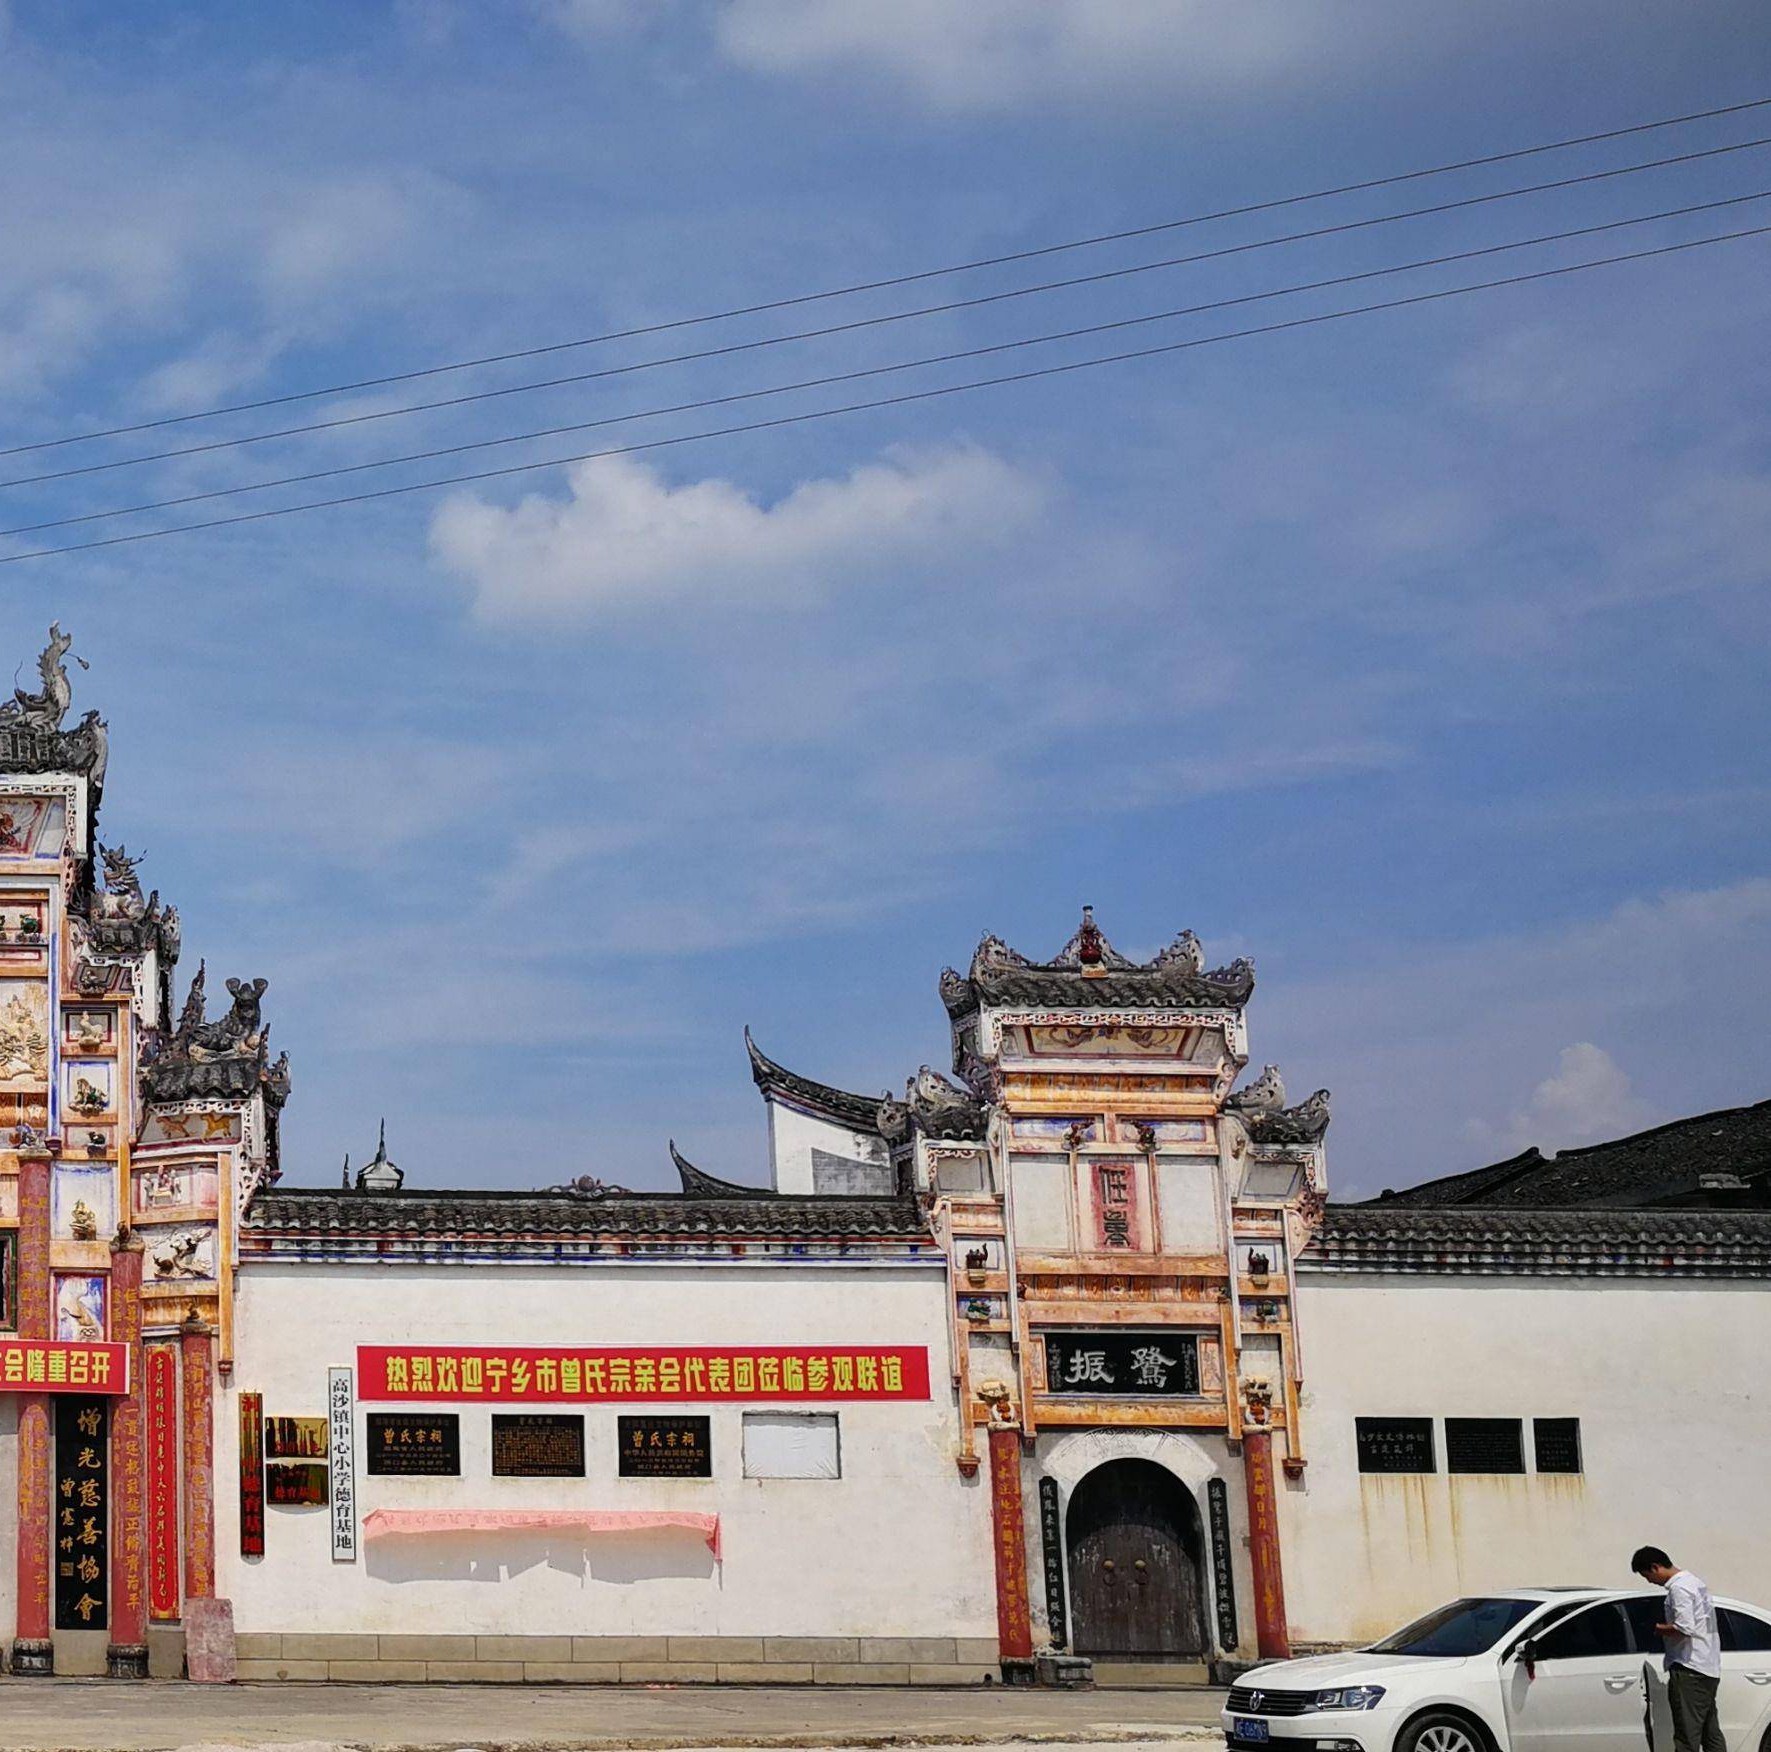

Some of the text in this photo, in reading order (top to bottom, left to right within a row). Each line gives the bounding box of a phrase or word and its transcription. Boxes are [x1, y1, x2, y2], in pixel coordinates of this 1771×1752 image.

[386, 1356, 903, 1393] 热烈欢迎宁乡市曾氏宗亲会代表团莅临参观联谊
[383, 1427, 442, 1444] 曾氏宗祠
[632, 1430, 695, 1447] 曾氏宗祠
[332, 1378, 353, 1551] 高沙镇中心小学德育基地
[74, 1408, 103, 1621] 增光慈善協會
